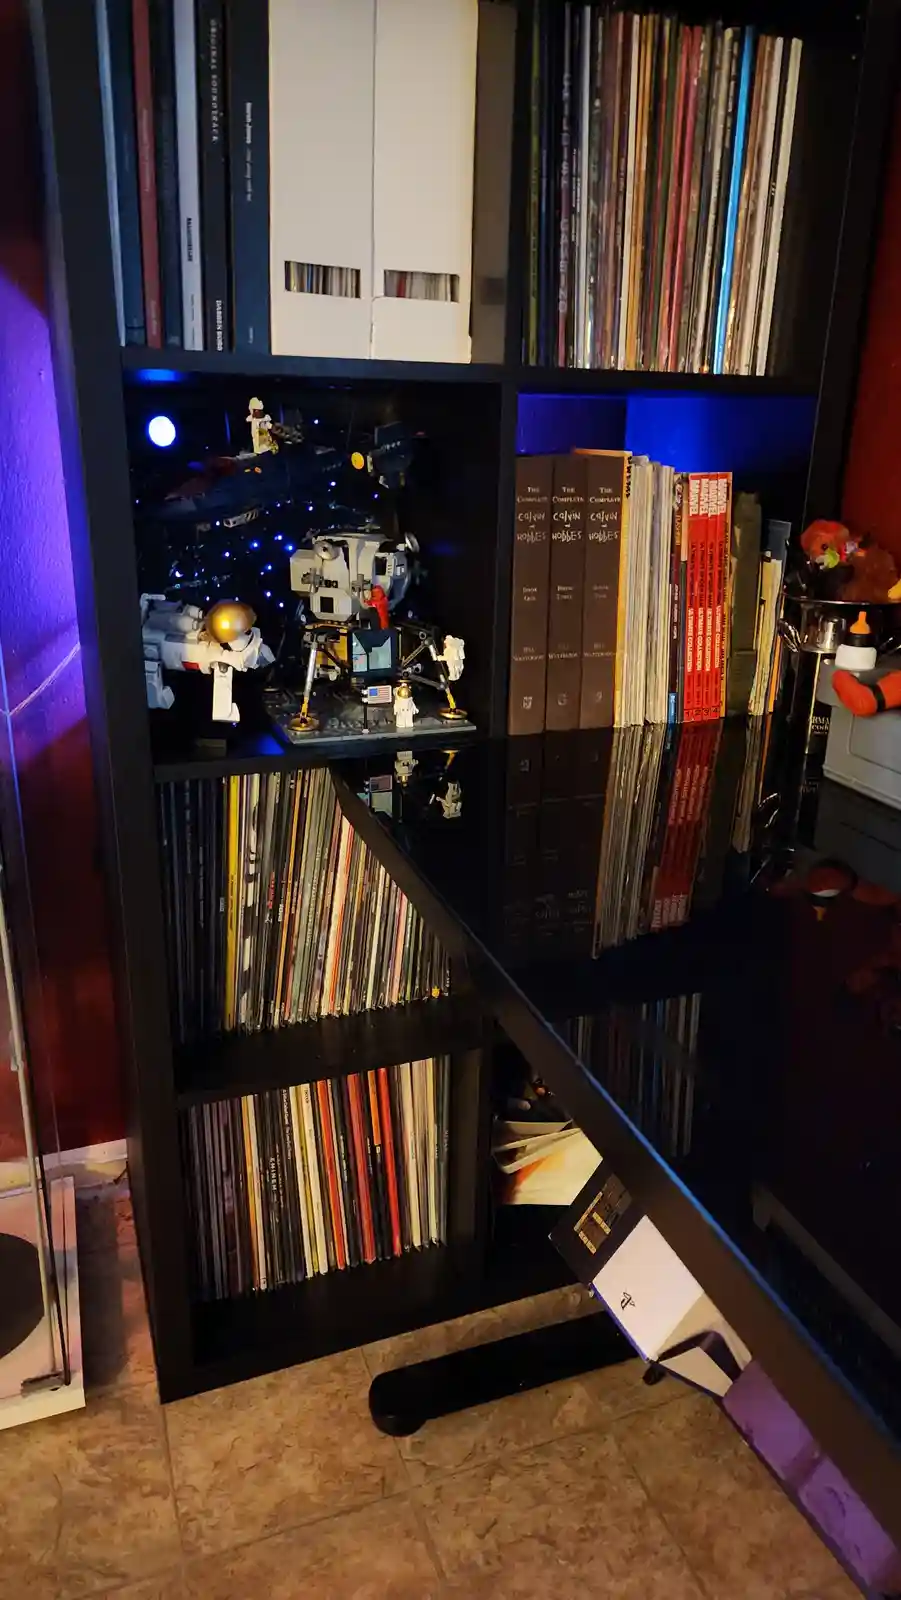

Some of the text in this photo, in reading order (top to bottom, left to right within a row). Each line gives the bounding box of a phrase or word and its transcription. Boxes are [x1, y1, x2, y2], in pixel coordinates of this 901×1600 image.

[690, 480, 700, 516] MARVEL
[699, 479, 709, 516] MARVEL
[708, 480, 718, 517] MARVEL
[553, 510, 581, 522] CALVIN
[590, 511, 618, 522] CALVIN
[552, 530, 582, 542] HOBBES
[588, 531, 619, 543] HOBBES
